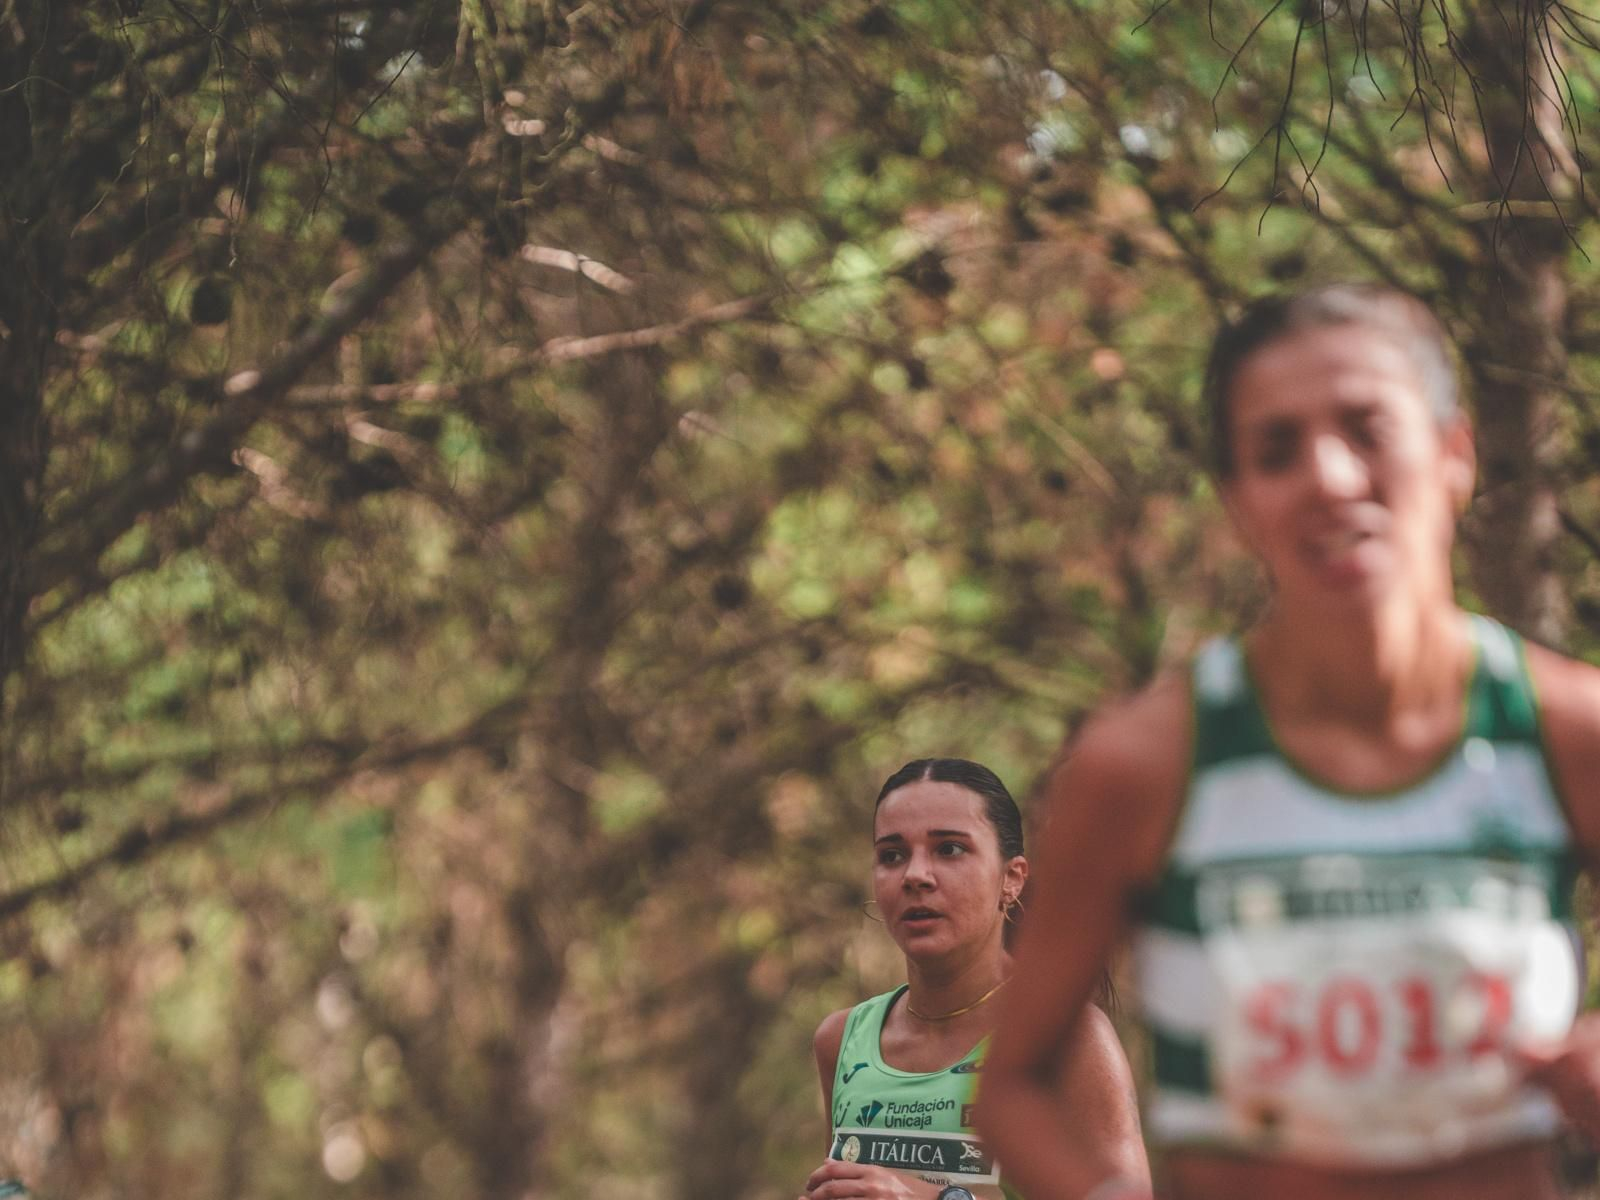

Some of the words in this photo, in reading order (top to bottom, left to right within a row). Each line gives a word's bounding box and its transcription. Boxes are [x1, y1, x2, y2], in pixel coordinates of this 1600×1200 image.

[886, 1098, 955, 1114] Fundación
[884, 1112, 932, 1129] Unicaja
[870, 1138, 945, 1165] ITÁLICA
[959, 1164, 980, 1173] Sevilla
